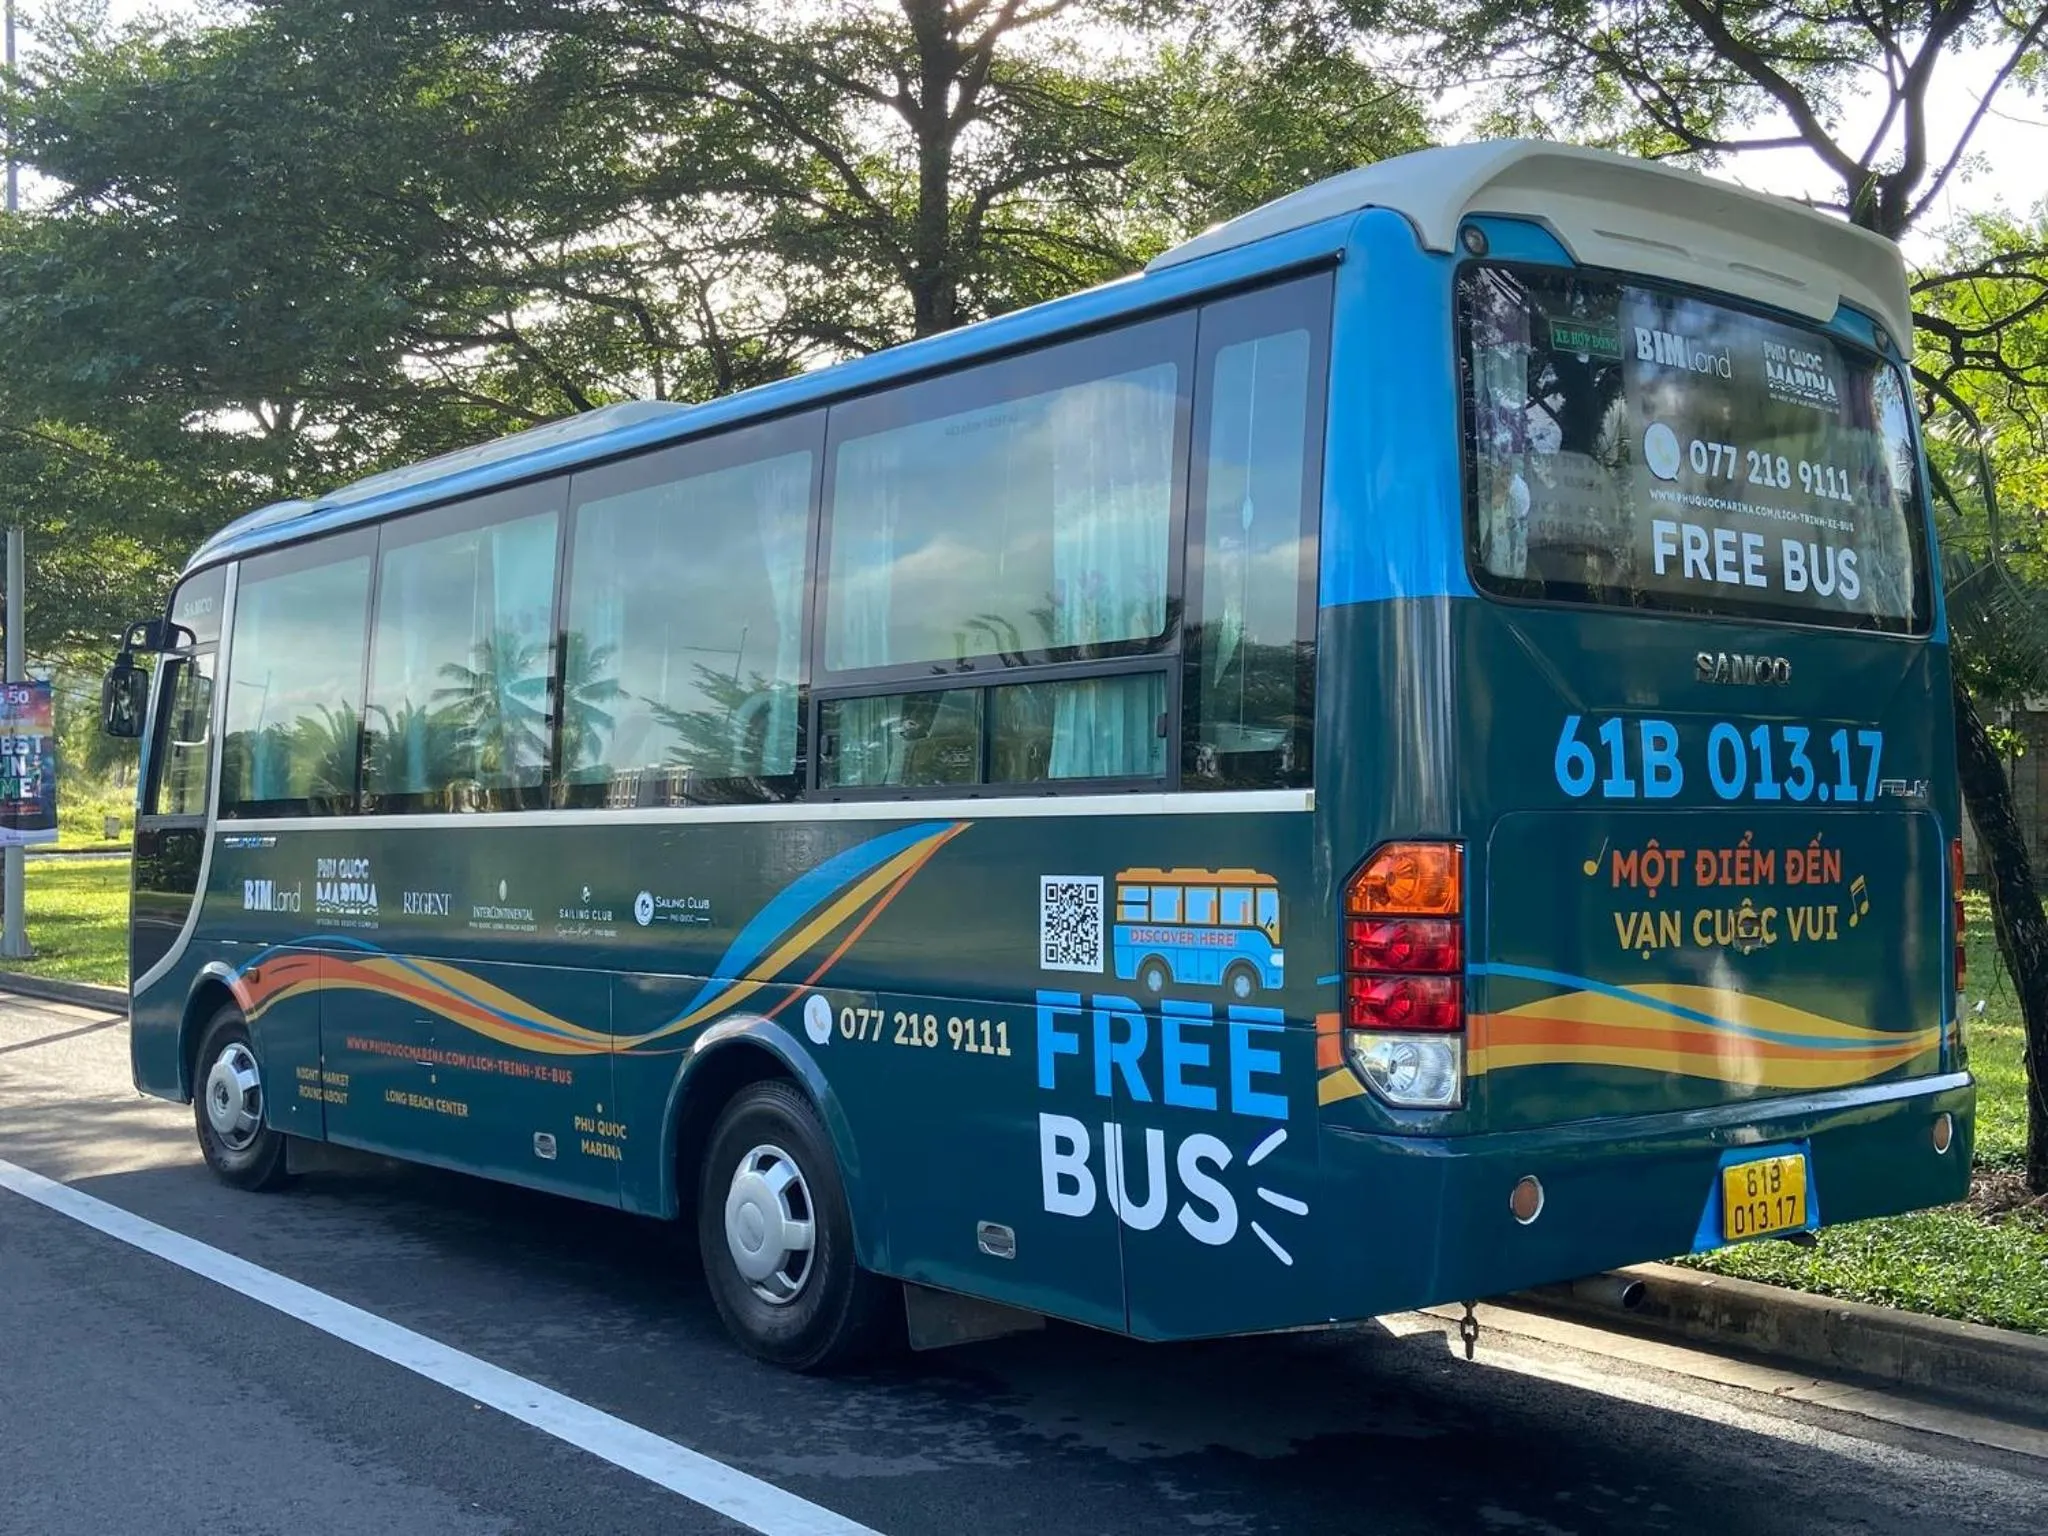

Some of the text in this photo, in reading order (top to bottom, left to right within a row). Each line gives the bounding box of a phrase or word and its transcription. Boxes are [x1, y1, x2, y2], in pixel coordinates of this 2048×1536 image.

[1690, 440, 1853, 502] 077 218 9111
[1652, 519, 1767, 589] FREE
[1782, 538, 1860, 600] BUS
[1695, 651, 1791, 687] SAMCO
[1554, 715, 1884, 802] 61B 013.17
[1612, 831, 1841, 897] MỘT ĐIỂM ĐẾN
[403, 891, 451, 916] REGENT
[559, 908, 613, 921] SAILING CLUB
[1130, 929, 1194, 945] DISCOVER
[1614, 897, 1838, 960] VẠN CUỘC VUI
[839, 1007, 1011, 1056] 077 218 9111
[1035, 989, 1289, 1120] FREE
[386, 1089, 469, 1117] LONG BEACH CENTER
[575, 1115, 627, 1140] PHU QUOC
[581, 1138, 623, 1161] MARINA
[1039, 1112, 1238, 1246] BUS
[1747, 1164, 1781, 1197] 61B
[1734, 1195, 1796, 1234] 013.17
